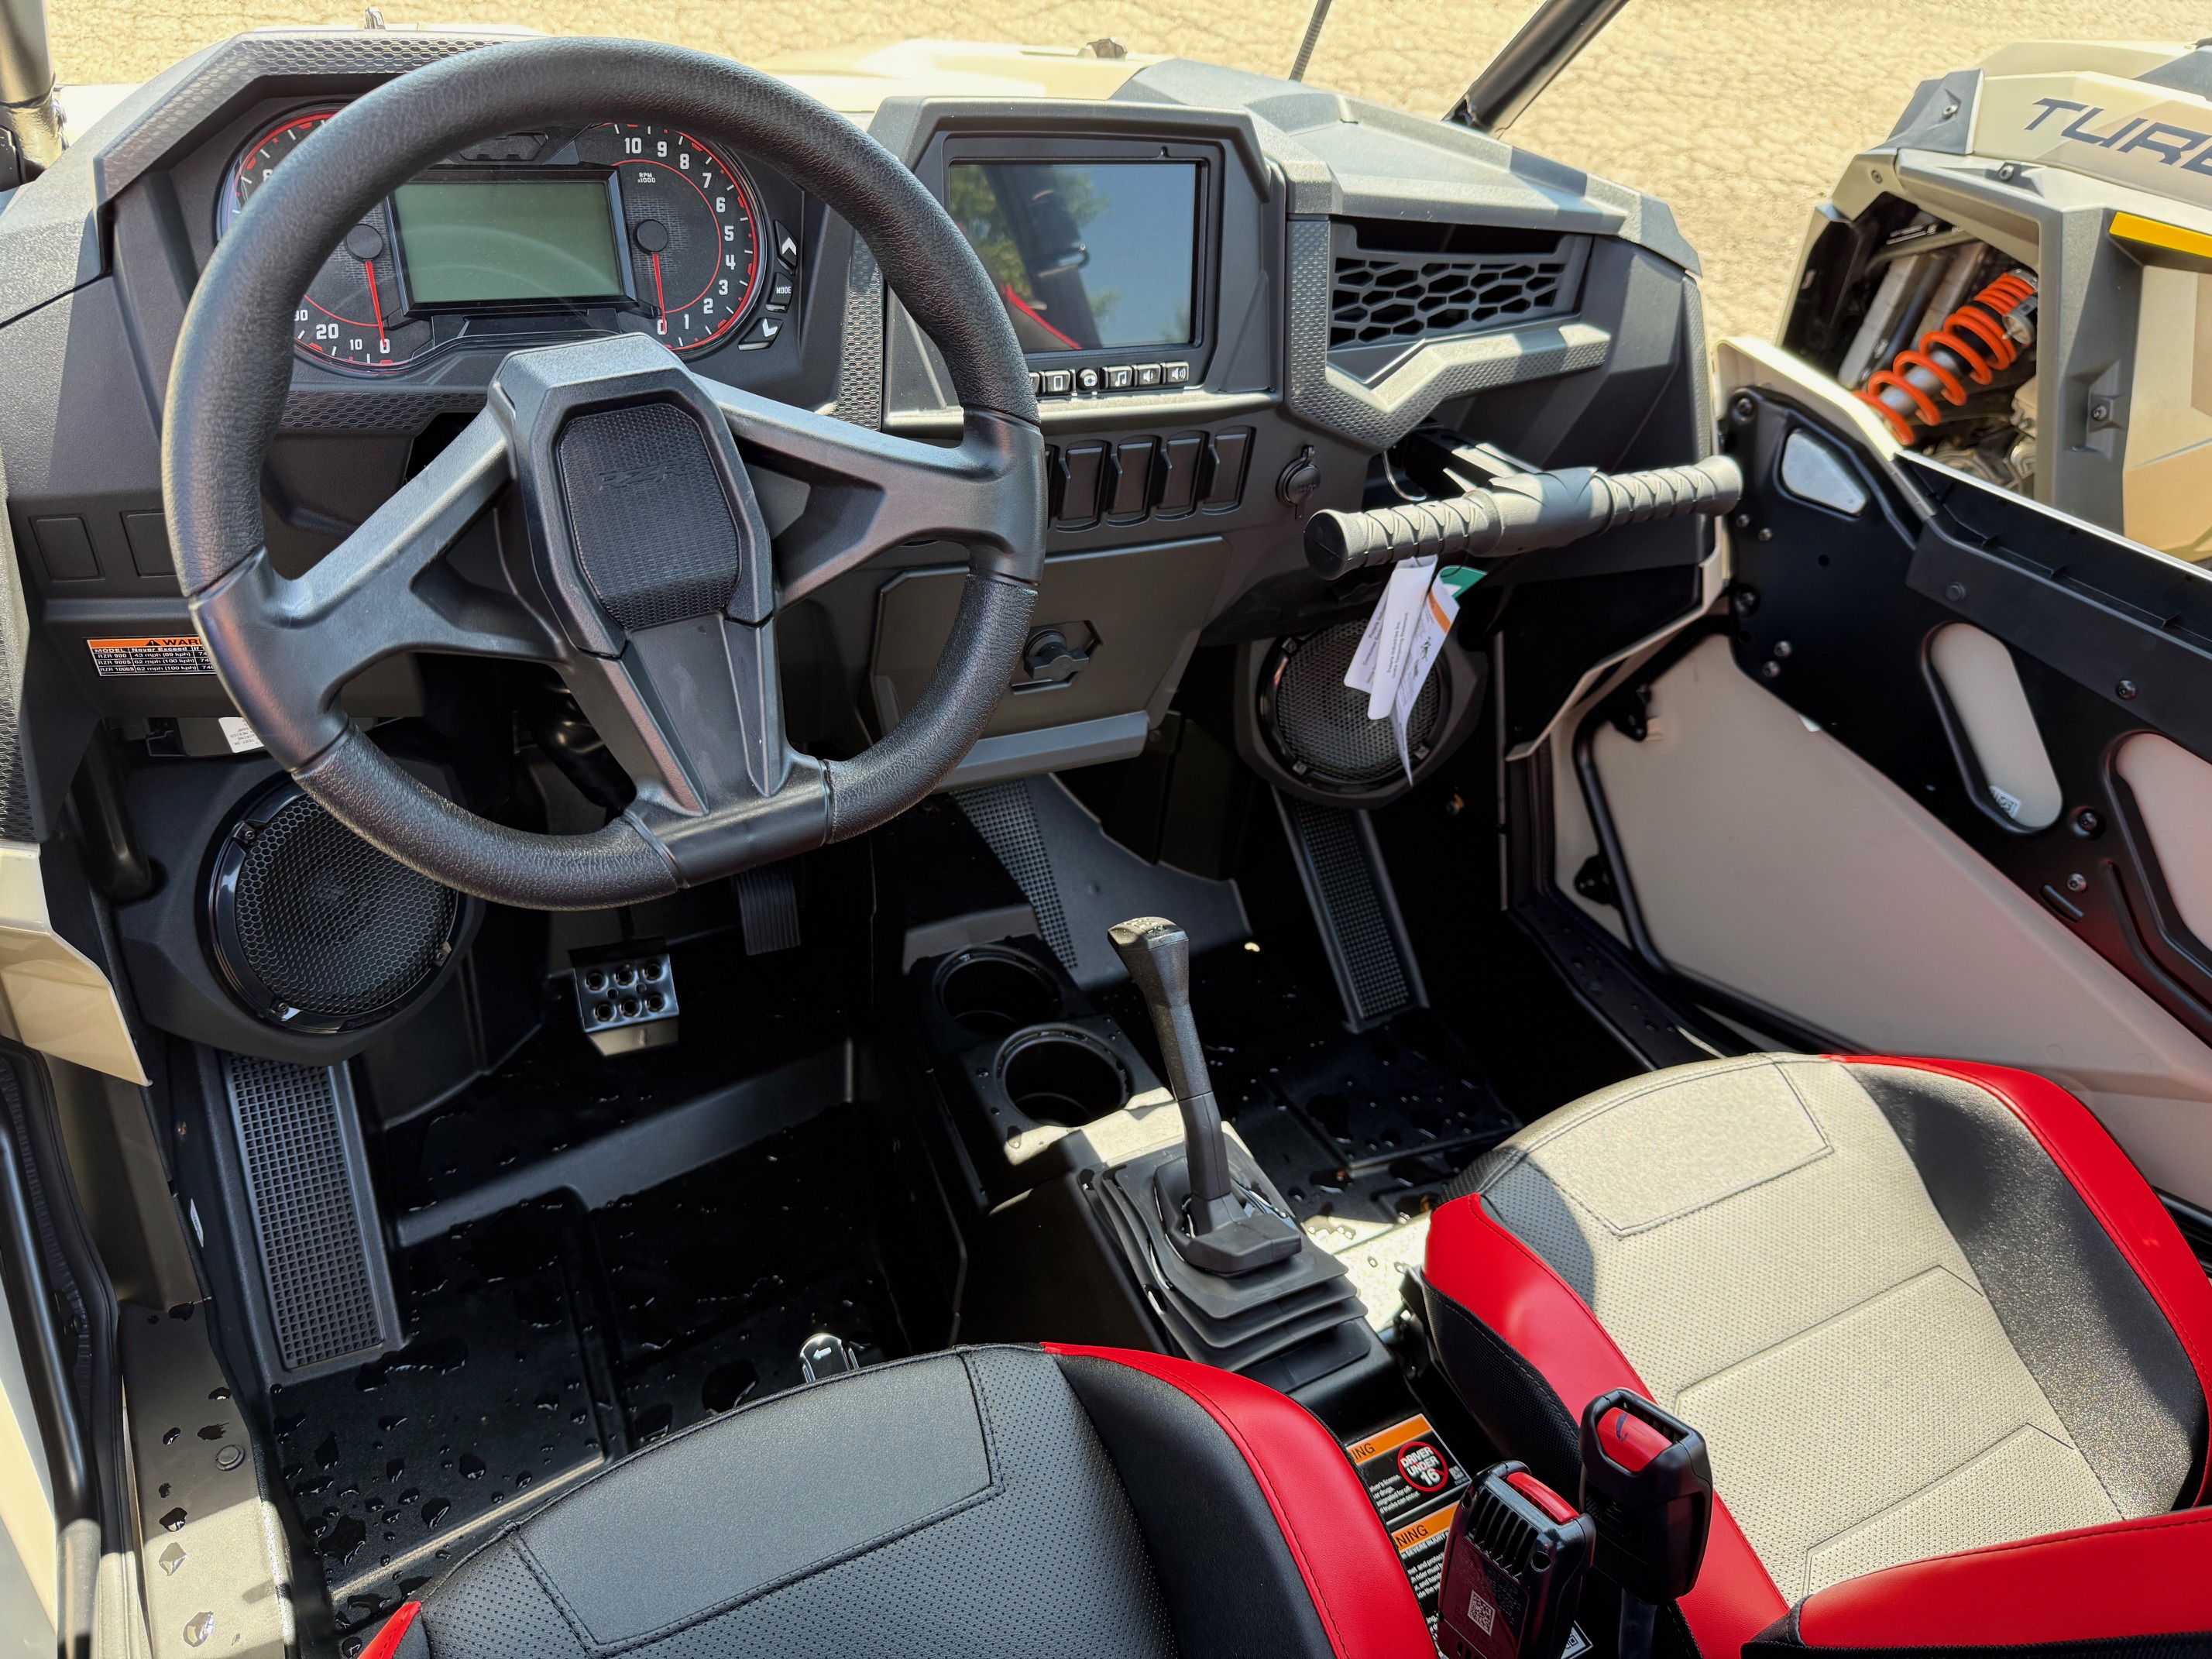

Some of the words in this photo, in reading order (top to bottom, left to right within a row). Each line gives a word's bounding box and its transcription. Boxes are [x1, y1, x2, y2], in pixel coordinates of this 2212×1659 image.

[625, 137, 642, 154] 10
[658, 141, 668, 157] 9
[679, 153, 690, 170] 8
[702, 172, 713, 188] 7
[716, 197, 726, 213] 6
[724, 225, 734, 242] 5
[726, 254, 736, 270] 4
[719, 280, 728, 295] 3
[776, 286, 792, 294] MODE
[703, 298, 713, 314] 2
[658, 319, 668, 335] 0
[684, 314, 689, 330] 1
[316, 323, 339, 339] 20
[349, 338, 362, 350] 10
[380, 338, 390, 354] 0
[594, 459, 689, 492] RZR
[1352, 1442, 1376, 1462] ING
[1400, 1446, 1434, 1468] DRIVER
[1406, 1455, 1441, 1478] UNDER
[1420, 1468, 1441, 1486] 16
